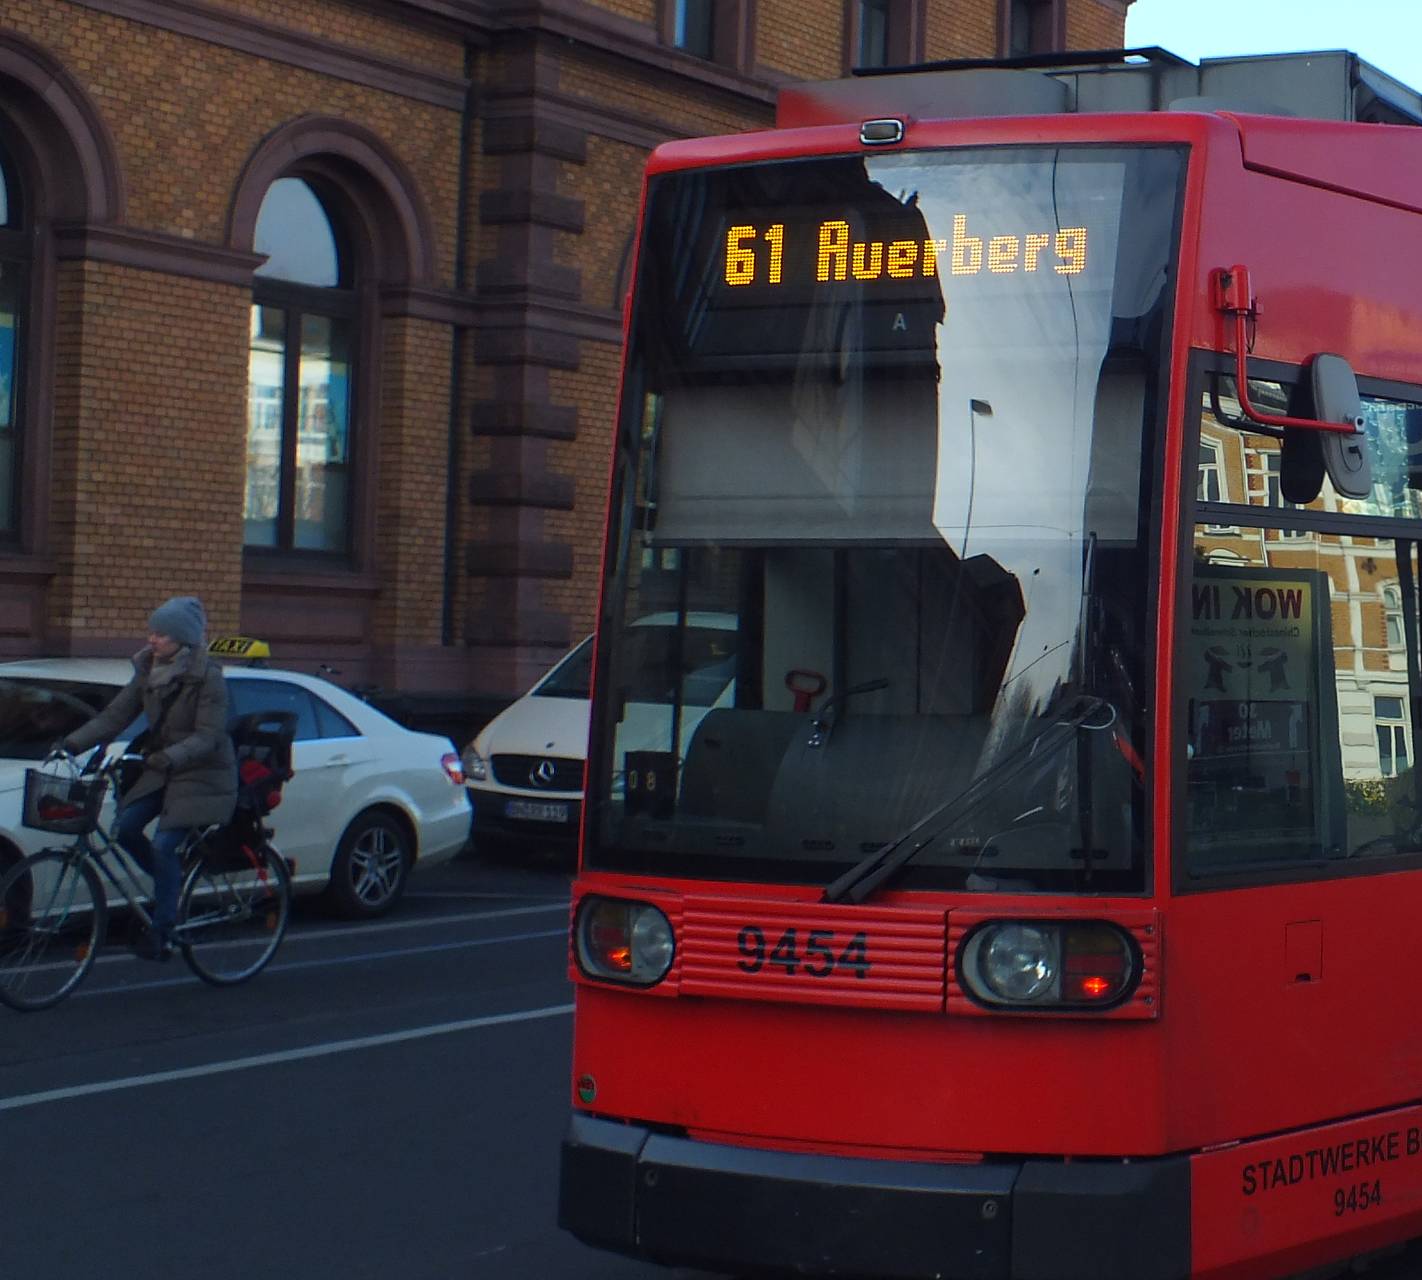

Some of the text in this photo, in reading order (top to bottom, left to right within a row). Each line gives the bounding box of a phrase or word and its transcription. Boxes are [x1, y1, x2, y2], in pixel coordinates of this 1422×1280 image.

[725, 214, 1088, 286] 61 Auerberg
[892, 312, 907, 330] A
[737, 925, 873, 979] 9454
[1242, 1132, 1400, 1196] STADTWERKE
[1334, 1179, 1382, 1217] 9454
